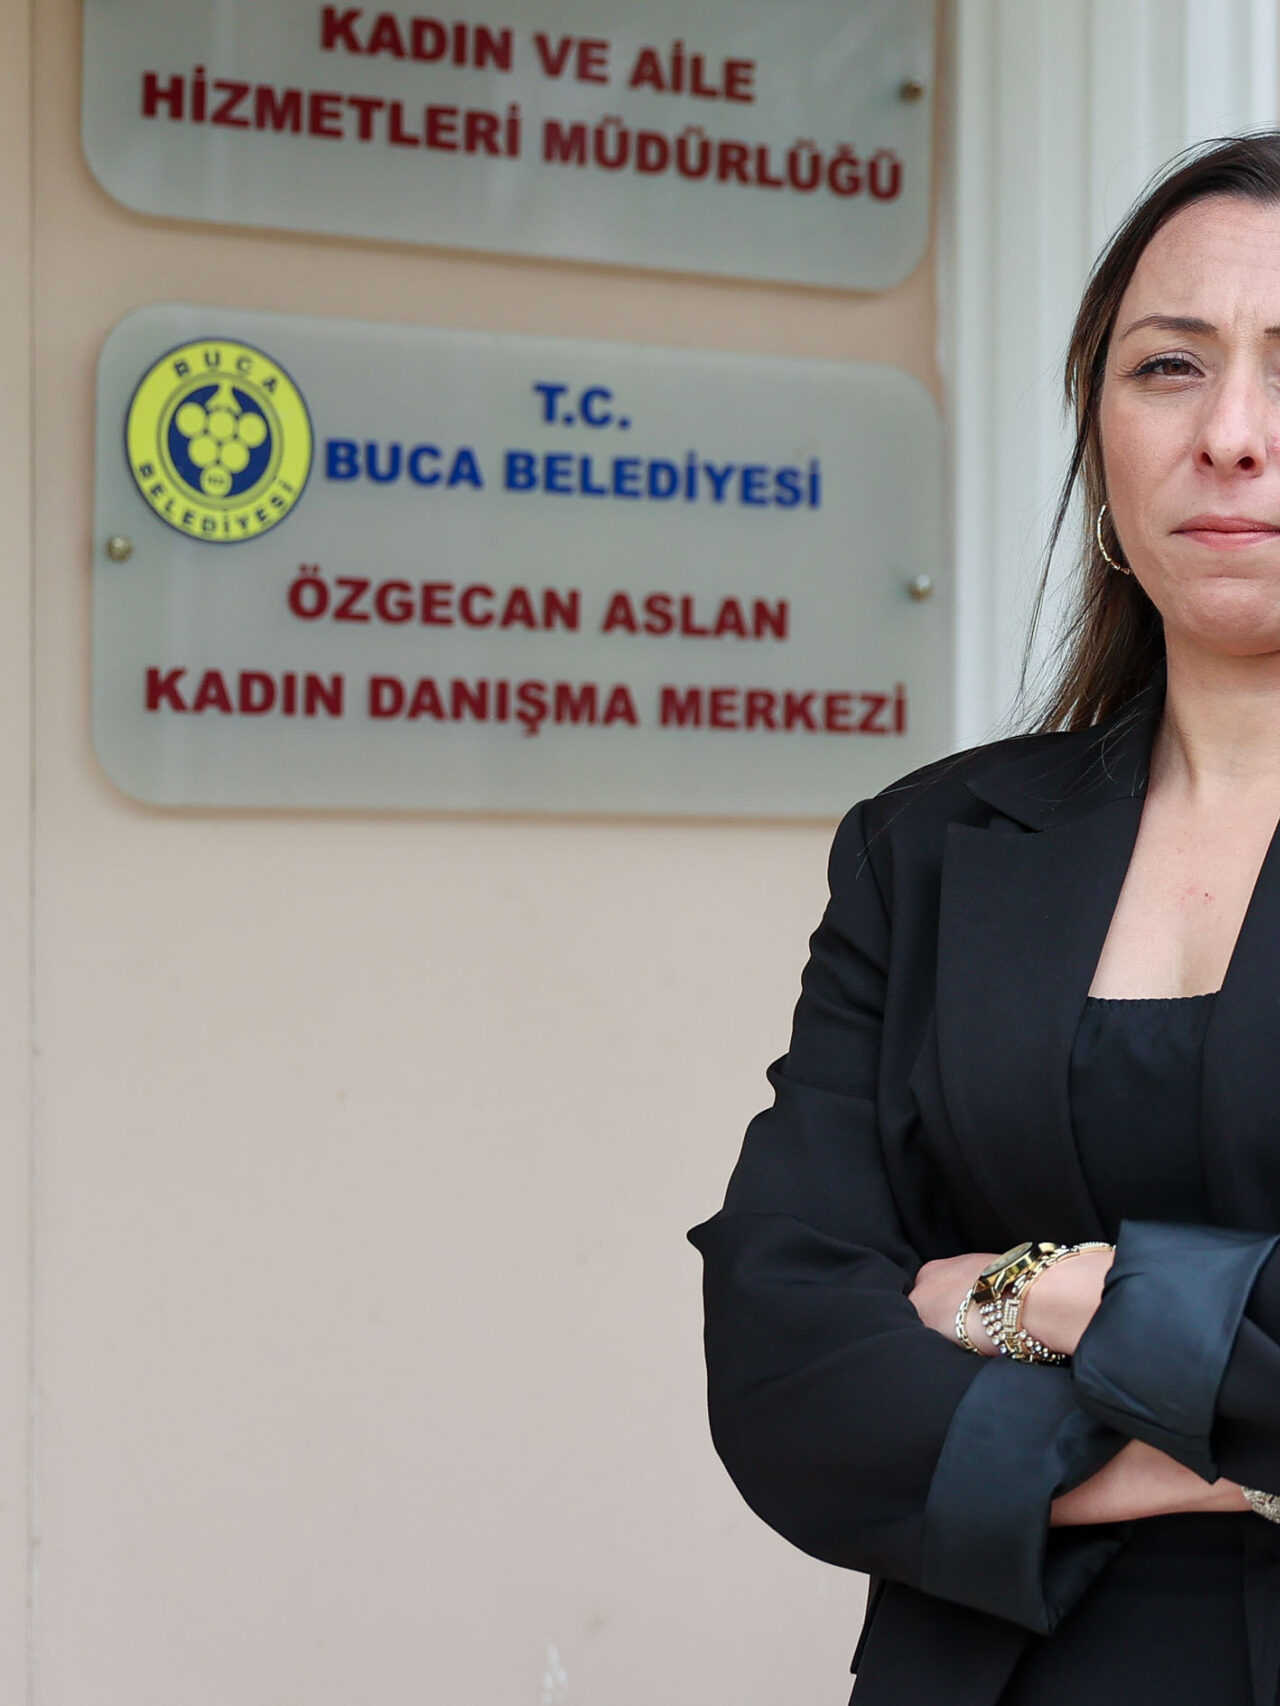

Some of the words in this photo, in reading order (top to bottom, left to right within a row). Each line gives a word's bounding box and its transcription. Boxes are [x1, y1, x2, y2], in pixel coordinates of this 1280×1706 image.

[320, 5, 513, 72] KADIN
[534, 32, 609, 84] VE
[630, 41, 756, 104] AİLE
[140, 66, 521, 159] HİZMETLERİ
[543, 116, 903, 202] MÜDÜRLÜĞÜ
[173, 350, 278, 394] BUCA
[534, 382, 633, 430] T.C.
[325, 438, 486, 490] BUCA
[504, 449, 823, 510] BELEDİYESİ
[287, 564, 581, 633] ÖZGECAN
[599, 592, 790, 641] ASLAN
[144, 666, 345, 718] KADIN
[367, 674, 640, 738] DANIŞMA
[659, 682, 907, 736] MERKEZİ
